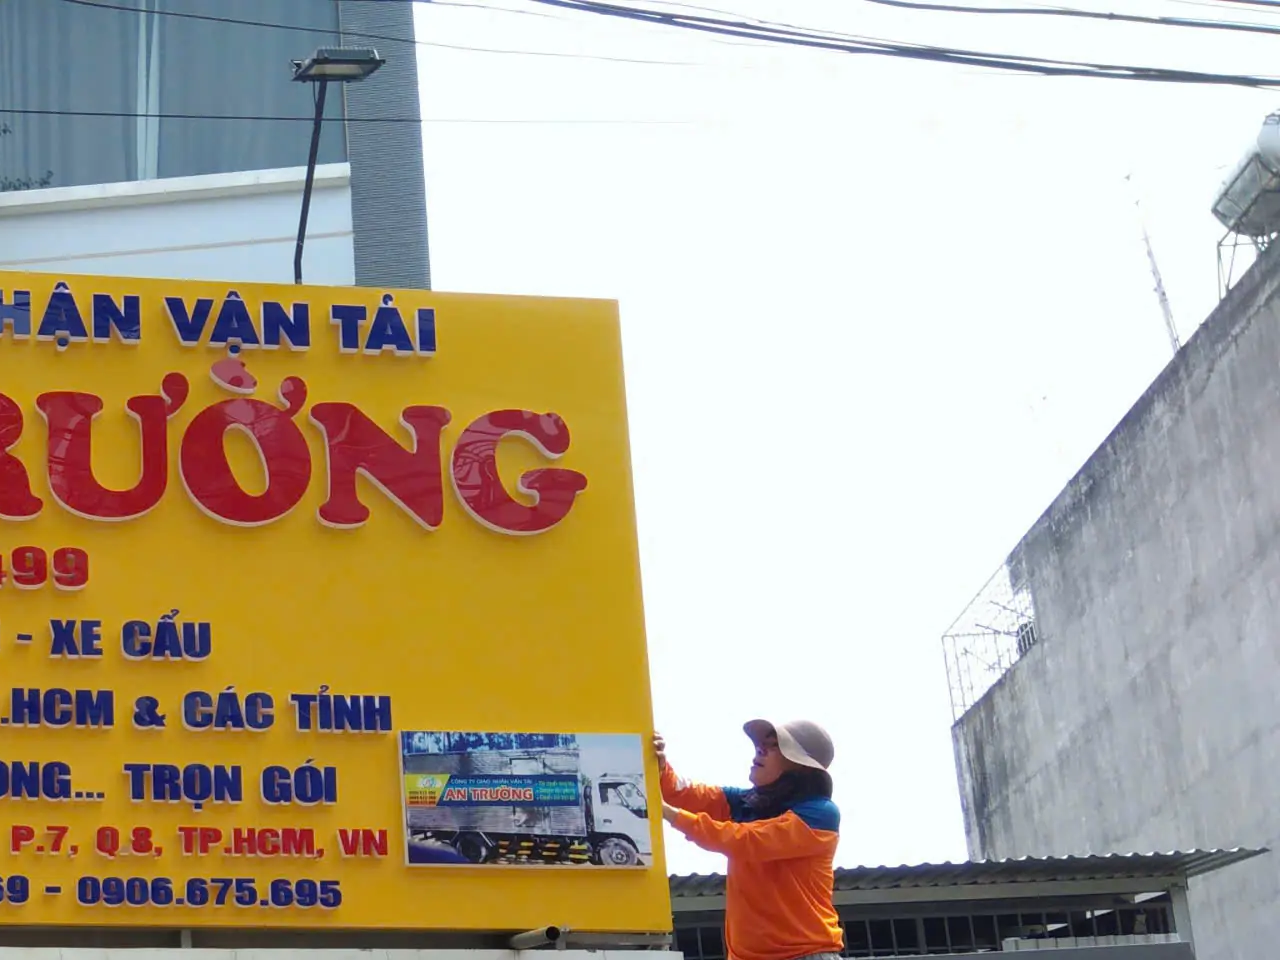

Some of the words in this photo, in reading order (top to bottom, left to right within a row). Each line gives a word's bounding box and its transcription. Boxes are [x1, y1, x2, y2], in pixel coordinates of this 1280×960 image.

[164, 290, 312, 357] VẬN
[331, 293, 437, 358] TẢI
[49, 618, 104, 660] XE
[122, 608, 212, 662] CẨU
[132, 695, 167, 729] &
[182, 686, 275, 733] CÁC
[289, 685, 394, 733] TỈNH
[122, 763, 243, 812] TRỌN
[260, 759, 338, 806] GÓI
[445, 787, 467, 801] AN
[470, 784, 533, 801] TRƯỜNG
[9, 825, 79, 859] P.7,
[177, 826, 325, 861] TP.HCM,
[337, 828, 390, 857] VN
[76, 875, 343, 909] 0906.675.695
